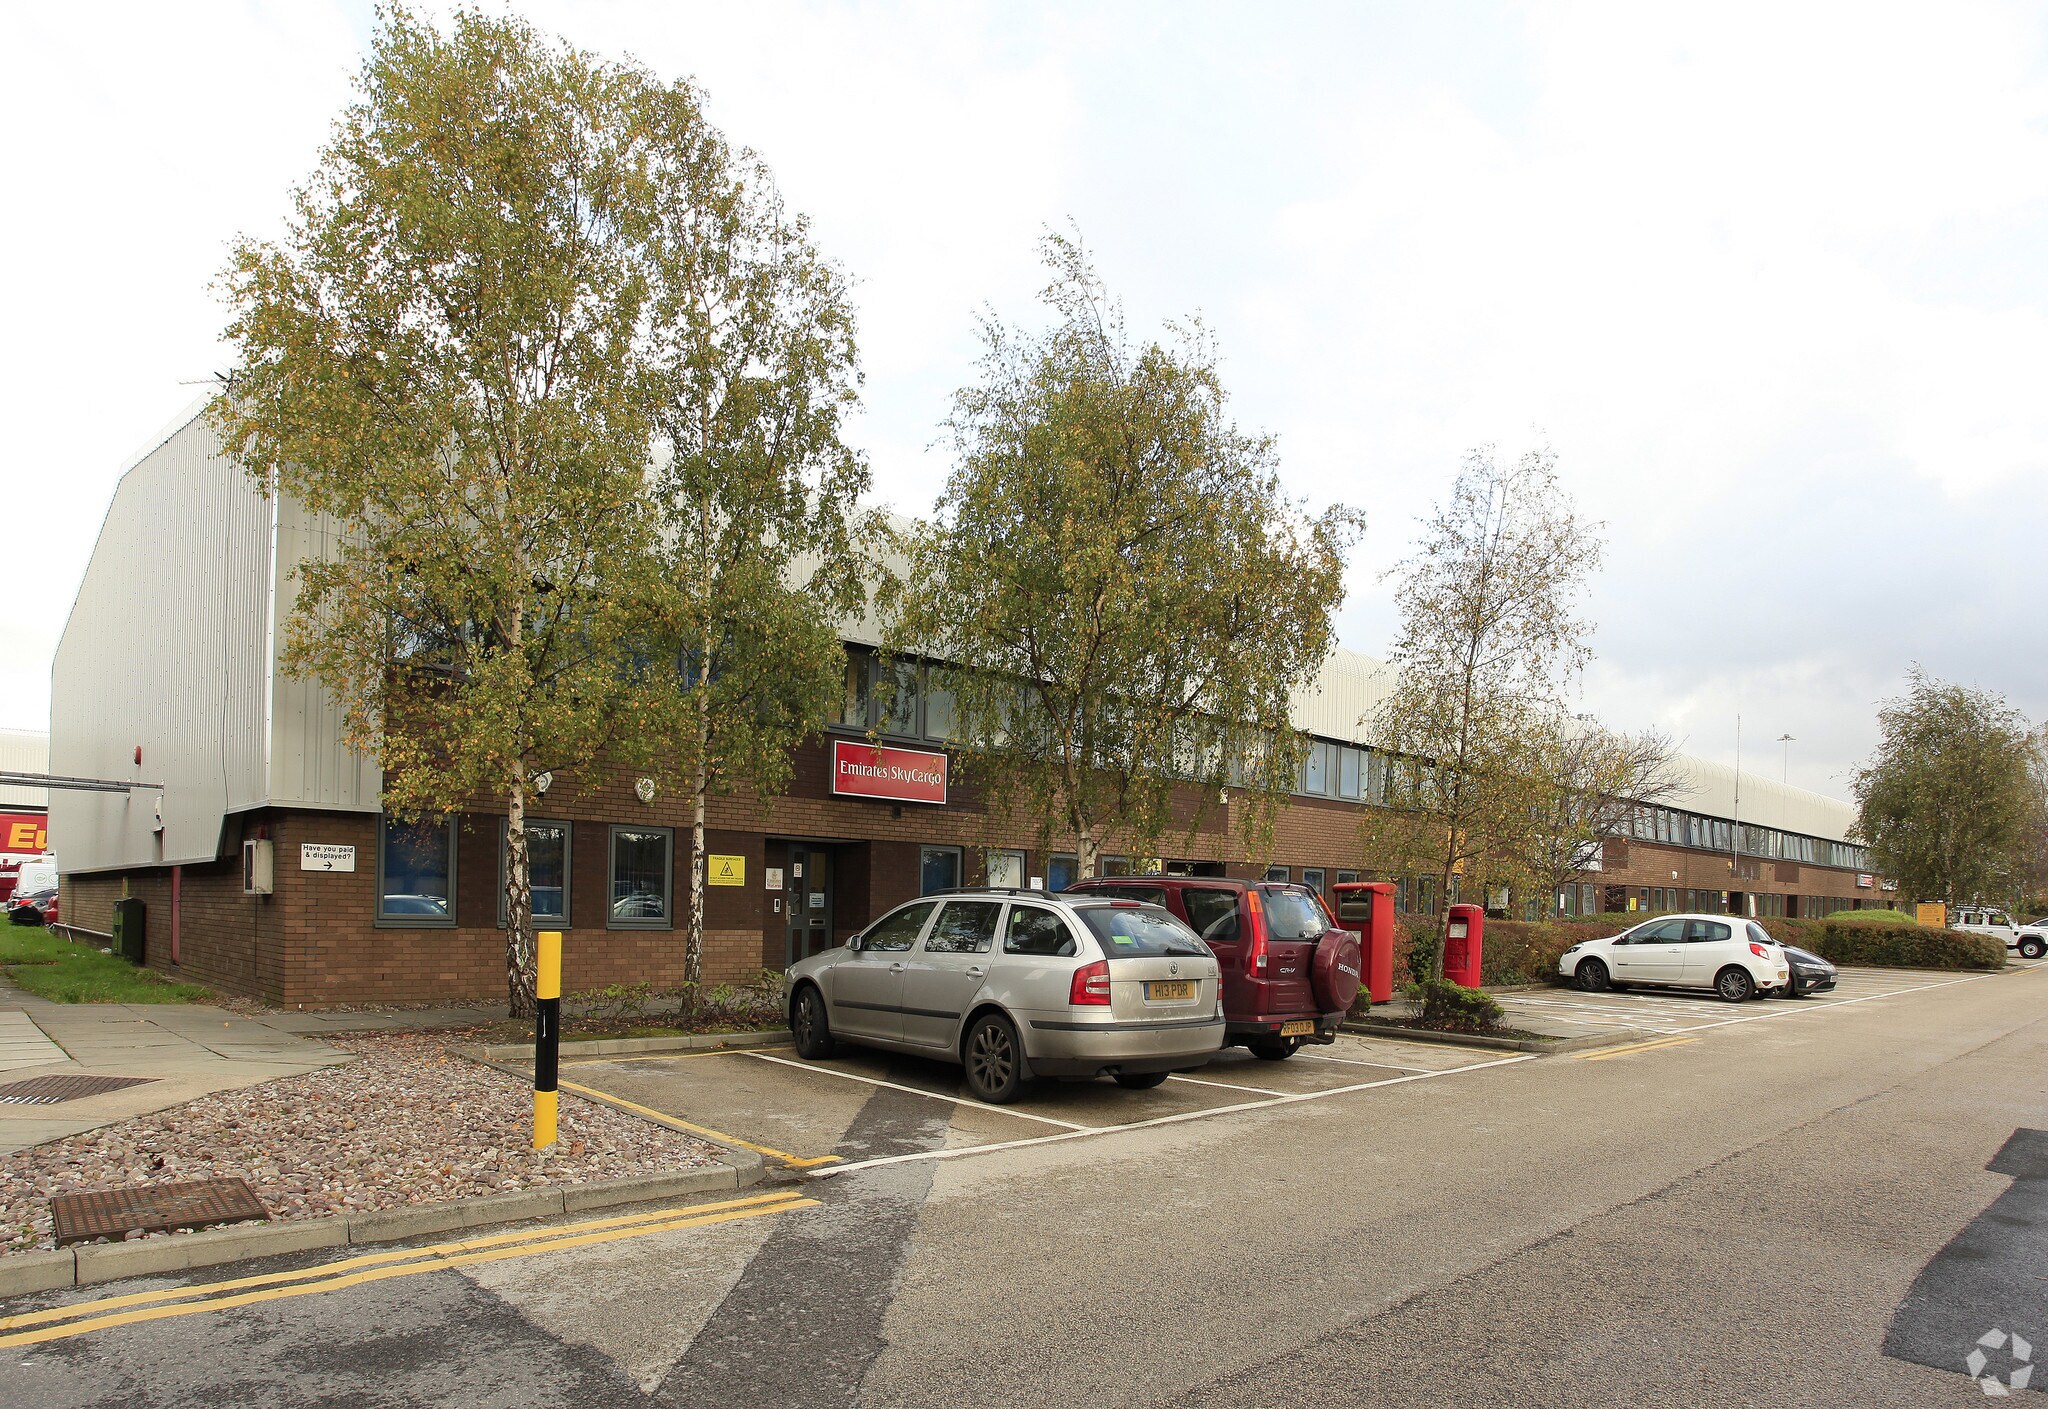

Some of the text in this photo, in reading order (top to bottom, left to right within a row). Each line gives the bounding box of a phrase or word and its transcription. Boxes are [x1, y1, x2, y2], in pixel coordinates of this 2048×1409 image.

[840, 760, 942, 787] Emirates SkyCargo
[312, 852, 351, 860] displayed?
[1337, 962, 1359, 978] HONDA
[1154, 983, 1189, 997] H13 PDR
